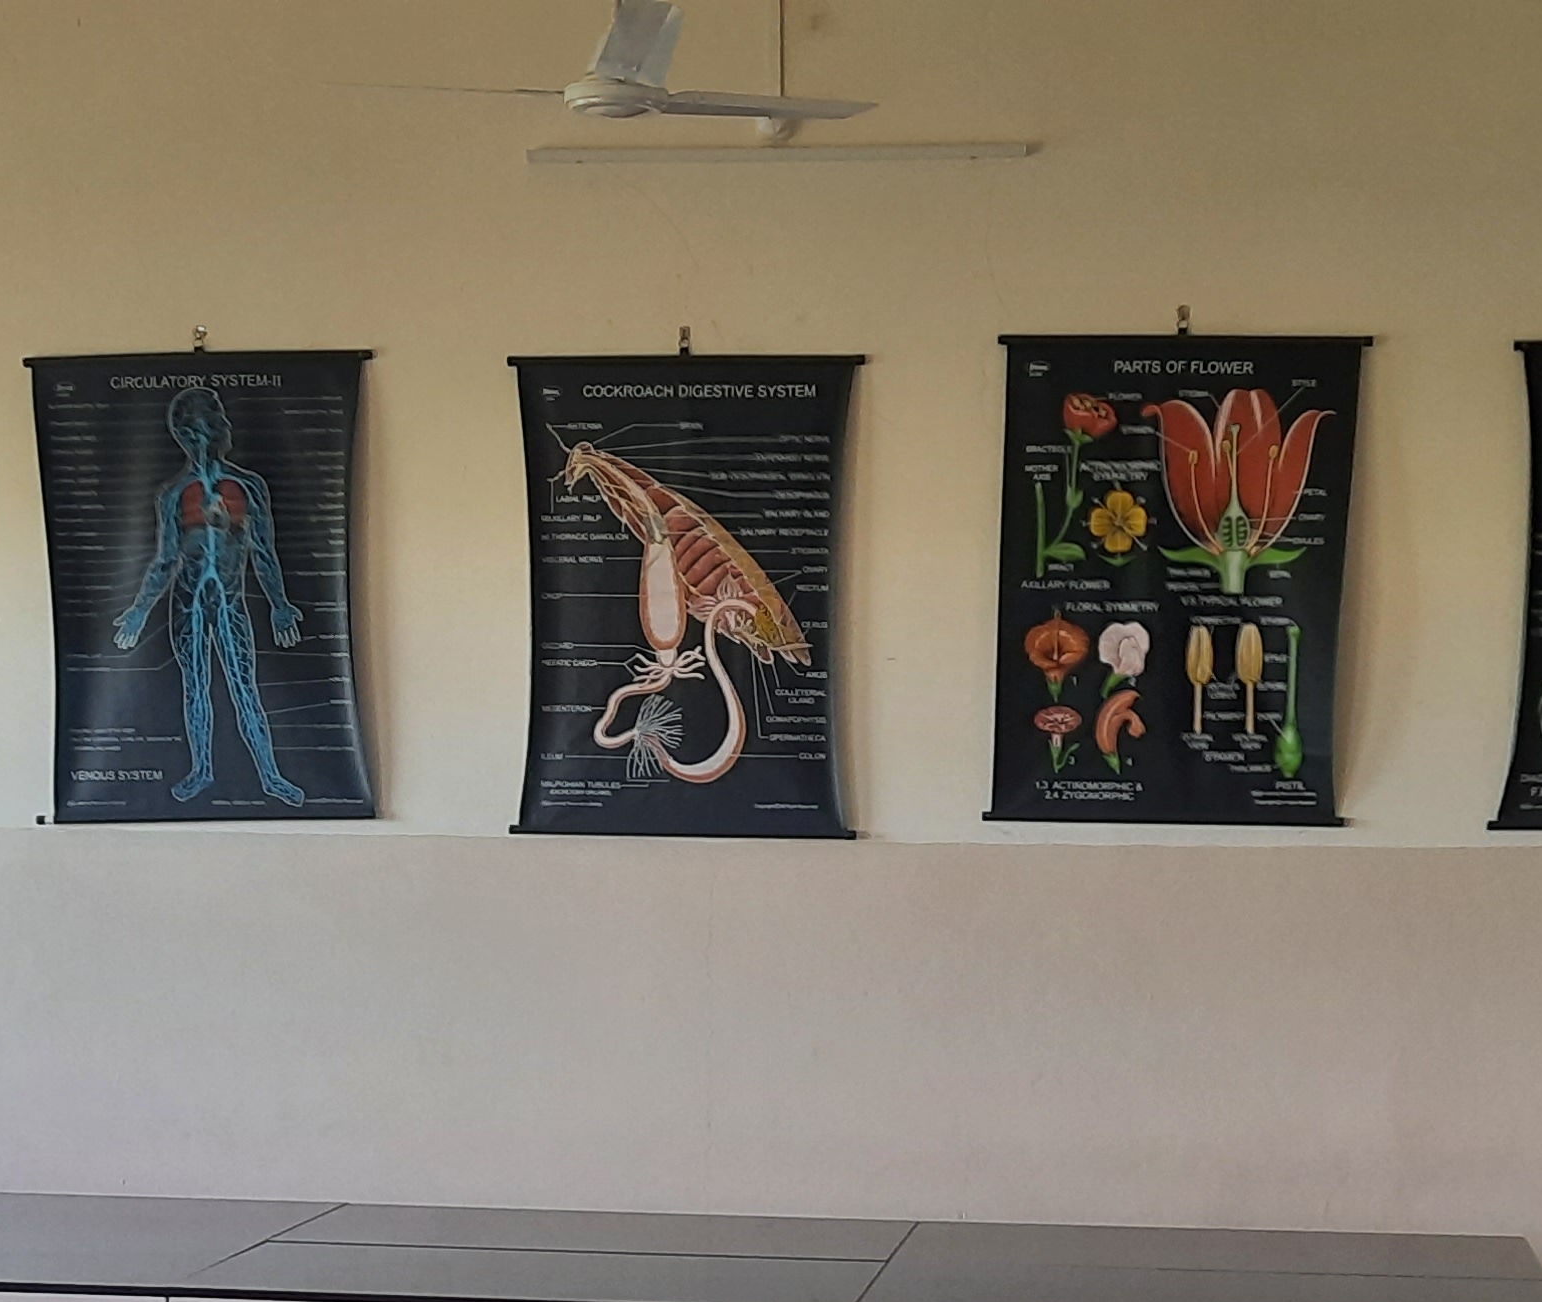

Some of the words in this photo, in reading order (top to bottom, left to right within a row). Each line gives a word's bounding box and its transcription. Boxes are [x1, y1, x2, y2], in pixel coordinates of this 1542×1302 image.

[1114, 361, 1160, 374] PARTS
[1166, 361, 1186, 373] OF
[1190, 361, 1254, 375] FLOWER
[110, 375, 206, 390] CIRCULATORY
[210, 374, 283, 388] SYSTEM-II
[582, 385, 674, 399] COCKROACH
[678, 385, 754, 399] DIGESTIVE
[757, 384, 817, 398] SYSTEM
[1024, 464, 1059, 473] MOTHER
[1020, 580, 1066, 590] AXILLARY
[1065, 601, 1104, 612] FLORAL
[799, 752, 826, 760] COLON
[71, 770, 115, 781] VENOUS
[118, 770, 163, 781] SYSTEM
